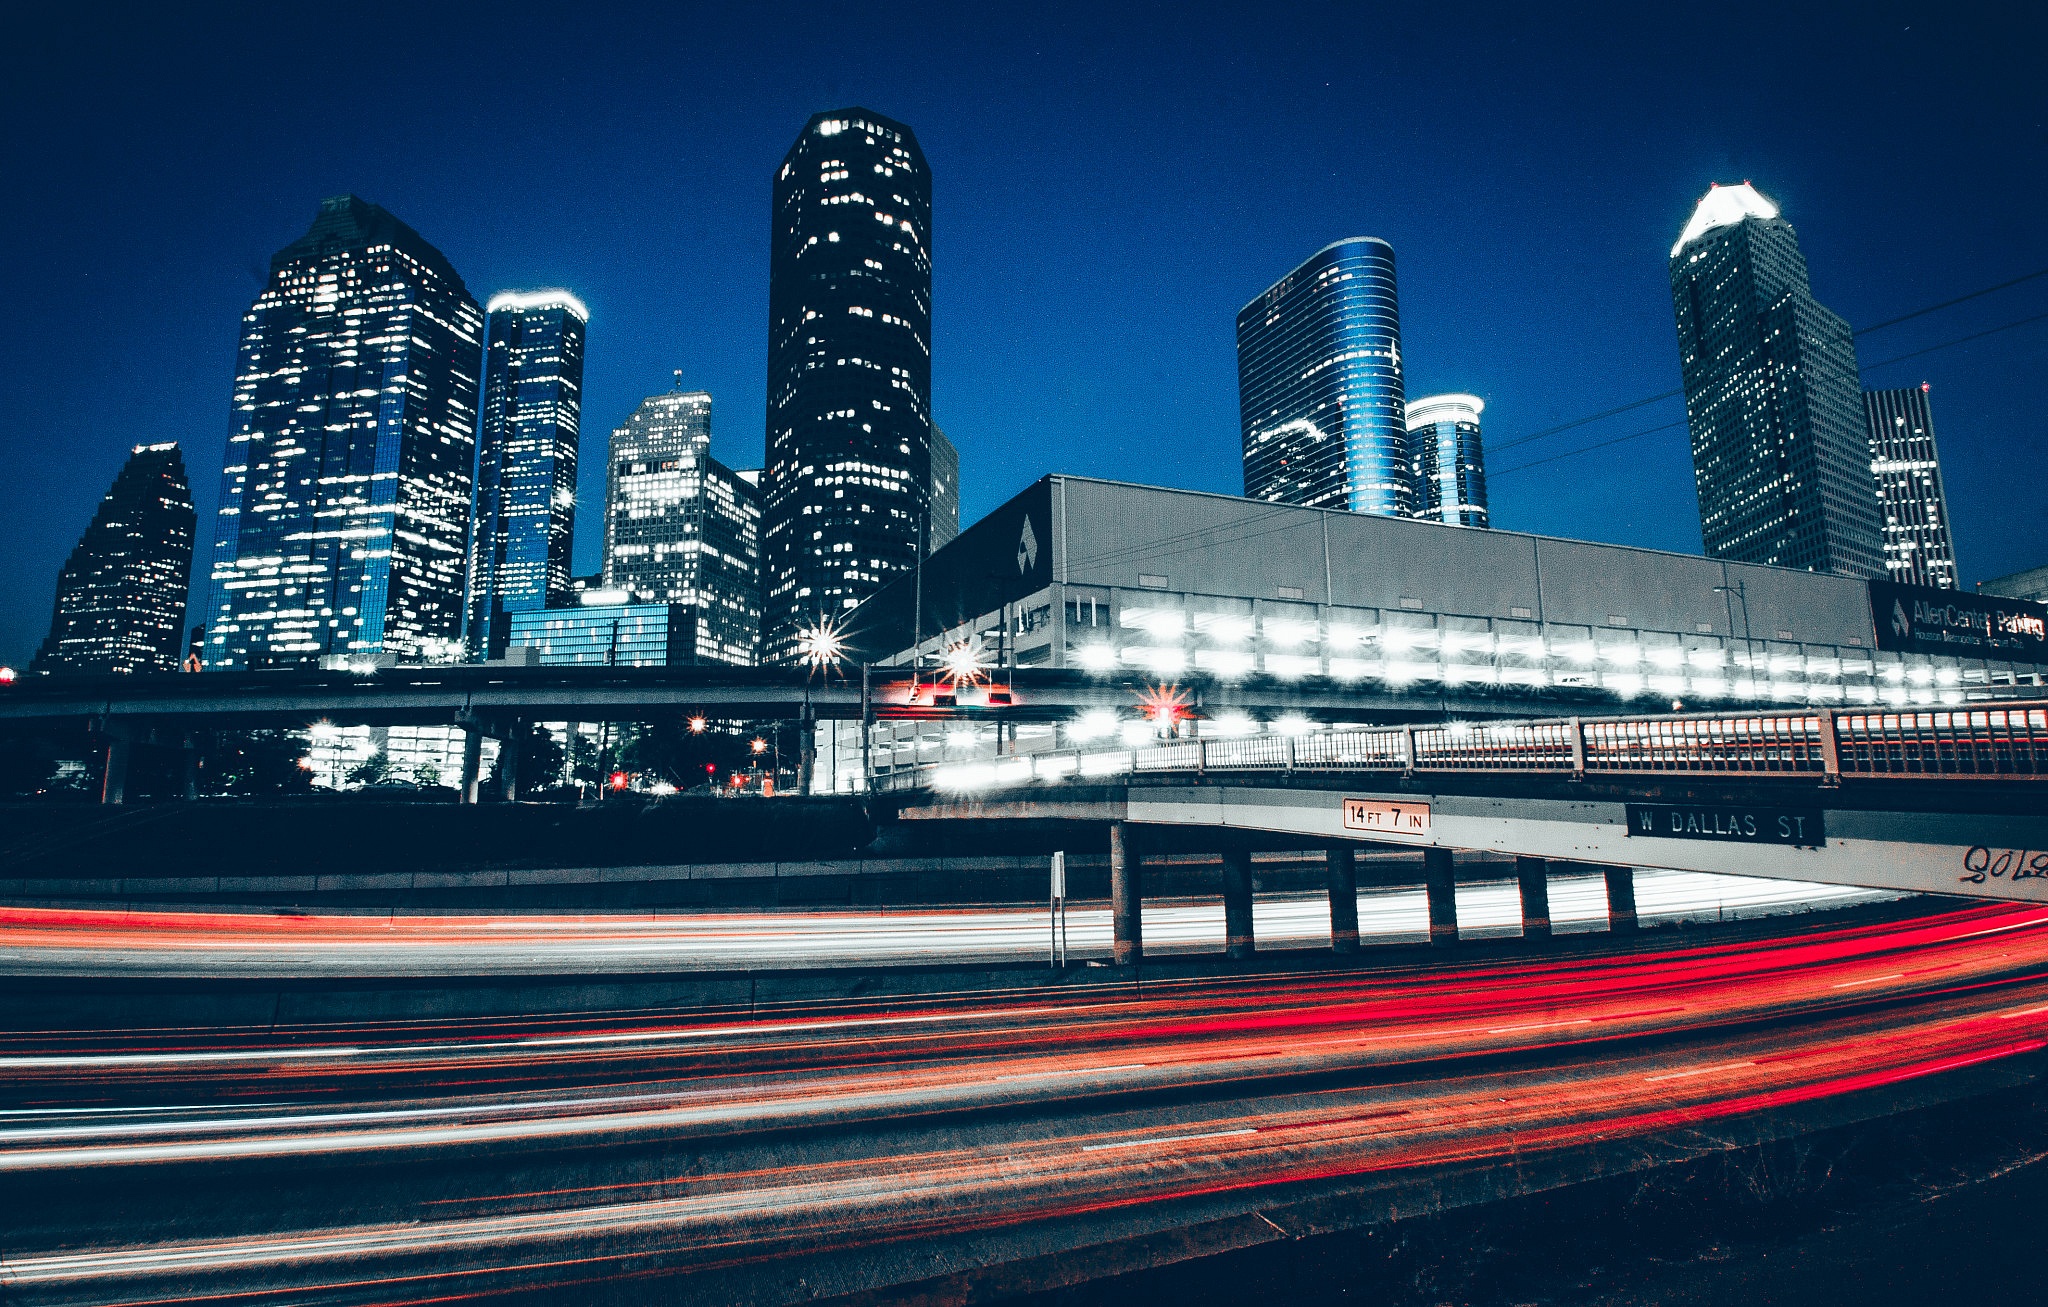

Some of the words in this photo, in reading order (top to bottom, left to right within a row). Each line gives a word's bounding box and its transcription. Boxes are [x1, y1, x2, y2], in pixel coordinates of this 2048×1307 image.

[1351, 806, 1365, 824] 14
[1368, 812, 1382, 825] FT
[1391, 808, 1401, 827] 7
[1409, 815, 1422, 828] IN
[1639, 811, 1653, 831] W
[1671, 812, 1757, 836] DALLAS
[1778, 815, 1806, 839] ST
